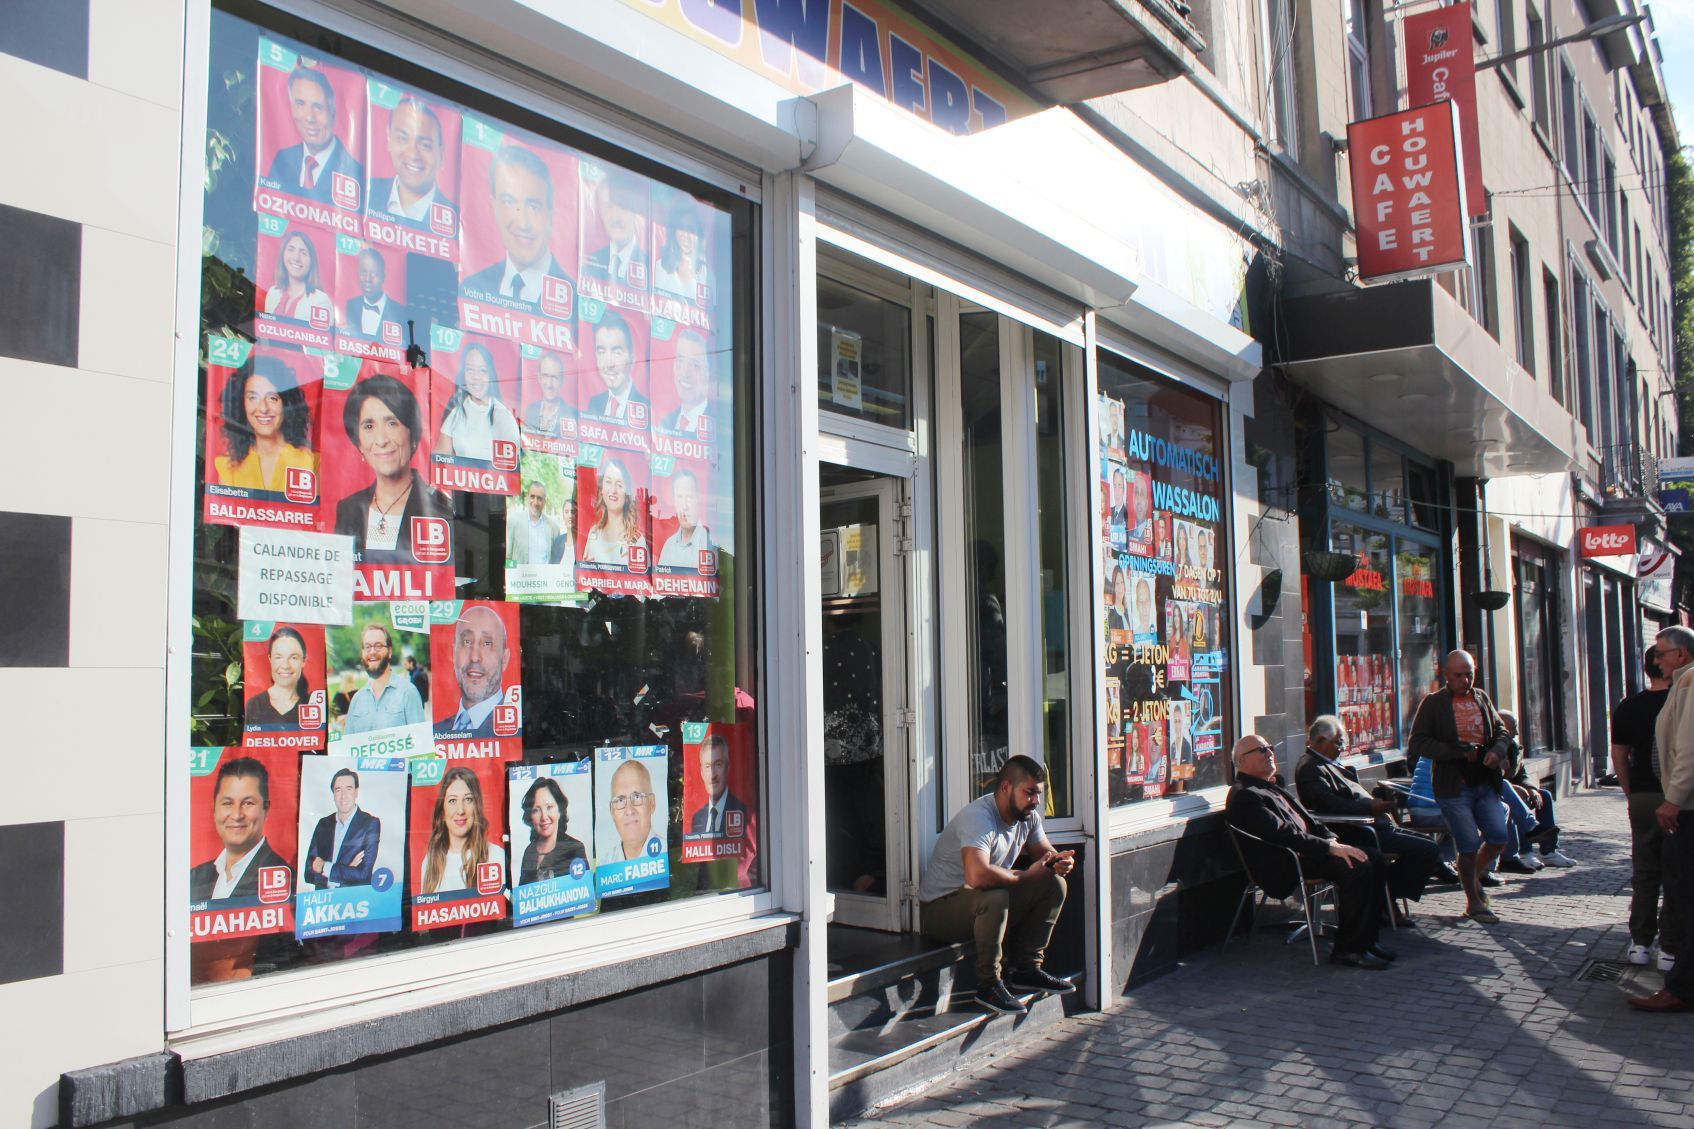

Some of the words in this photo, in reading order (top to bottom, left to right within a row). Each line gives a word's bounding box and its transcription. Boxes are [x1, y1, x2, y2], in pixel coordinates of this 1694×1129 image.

[1423, 48, 1458, 64] Jupiler
[259, 177, 282, 191] Kadir
[336, 177, 356, 198] LB
[1401, 118, 1435, 261] HOUWAERT
[1370, 145, 1398, 251] CAFE
[263, 217, 279, 231] 18
[433, 206, 453, 226] LB
[368, 222, 450, 258] BOÏKETÉ
[545, 279, 569, 303] LB
[464, 287, 485, 301] Votre
[485, 291, 533, 313] Bourgmestre
[312, 307, 328, 321] LB
[583, 303, 598, 317] 19
[385, 323, 400, 337] LB
[463, 302, 523, 338] Emir
[529, 318, 574, 351] KIR
[438, 330, 453, 346] 10
[213, 340, 241, 359] 24
[339, 340, 401, 360] BASSAMBI
[630, 404, 645, 419] LB
[562, 421, 574, 432] LB
[580, 424, 608, 441] SAFA
[612, 431, 647, 449] AKYOL
[494, 442, 514, 459] LB
[1129, 429, 1219, 480] AUTOMATISCH
[289, 467, 312, 490] LB
[435, 467, 509, 492] ILUNGA
[209, 485, 249, 498] Elisabetta
[1152, 480, 1220, 522] WASSALON
[209, 503, 314, 526] BALDASSARRE
[417, 522, 445, 545] LB
[1584, 532, 1629, 550] Lotto
[253, 543, 322, 561] CALANDRE
[324, 549, 341, 562] DE
[630, 548, 645, 563] LB
[701, 551, 715, 566] LB
[260, 568, 333, 585] REPASSAGE
[353, 570, 434, 597] AMLI
[580, 576, 622, 590] GABRIELA
[655, 577, 717, 594] DEHENAIN
[259, 592, 333, 609] DISPONIBLE
[435, 602, 454, 617] 29
[252, 624, 261, 636] 4
[1139, 644, 1170, 664] JETON
[316, 692, 324, 704] 5
[511, 688, 520, 702] 5
[302, 706, 319, 720] LB
[497, 708, 515, 724] LB
[1140, 700, 1171, 722] JETONS
[688, 724, 701, 738] 13
[246, 736, 319, 748] DESLOOVER
[350, 733, 415, 758] DEFOSSÉ
[435, 742, 500, 760] SMAHI
[605, 750, 622, 760] 12
[634, 747, 653, 756] MR
[360, 758, 386, 770] MR
[417, 762, 438, 778] 20
[553, 765, 575, 774] MR
[513, 770, 531, 780] 12
[728, 814, 741, 826] LB
[650, 842, 660, 853] 11
[685, 846, 714, 858] HALIL
[716, 842, 742, 855] DISLI
[481, 865, 499, 882] LB
[572, 863, 584, 875] 12
[600, 872, 624, 887] MARC
[624, 858, 666, 881] FABRE
[263, 870, 286, 889] LB
[378, 874, 387, 886] 7
[303, 891, 333, 905] HALIT
[520, 882, 560, 899] NAZGUL
[520, 886, 590, 915] BALMUKHANOVA
[190, 907, 285, 936] UAHABI
[303, 900, 369, 926] AKKAS
[417, 901, 500, 925] HASANOVA
